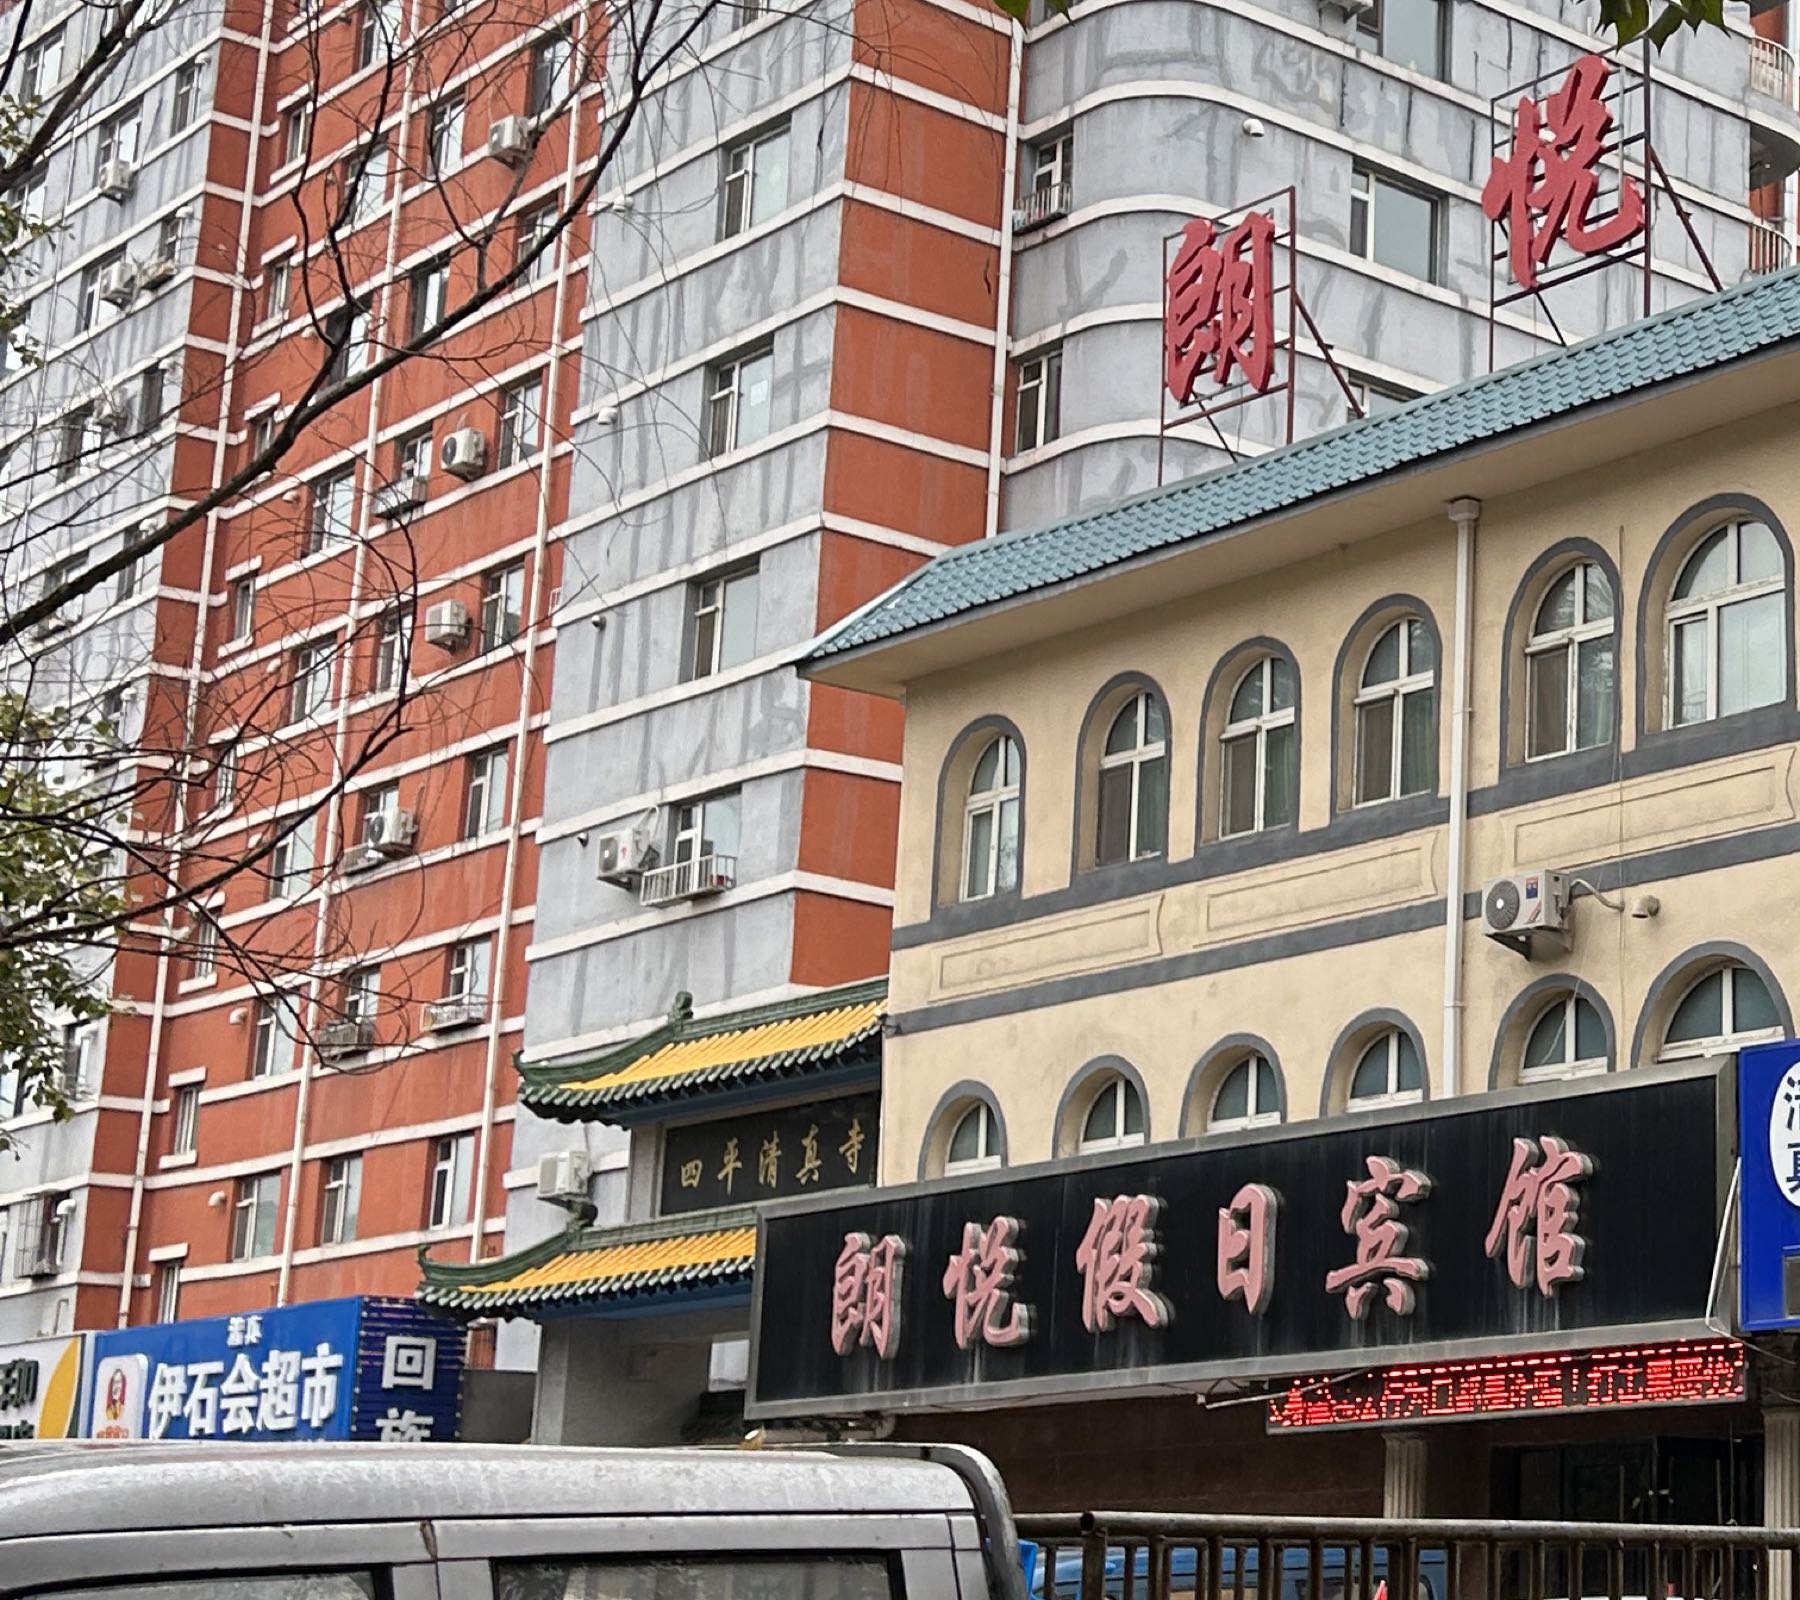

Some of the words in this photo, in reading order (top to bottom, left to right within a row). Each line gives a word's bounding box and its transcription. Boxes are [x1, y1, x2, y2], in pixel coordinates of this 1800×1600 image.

[680, 1117, 866, 1196] 四平清真寺
[830, 1133, 1599, 1361] 朗悦假日宾馆
[149, 1343, 343, 1441] 伊石会超市
